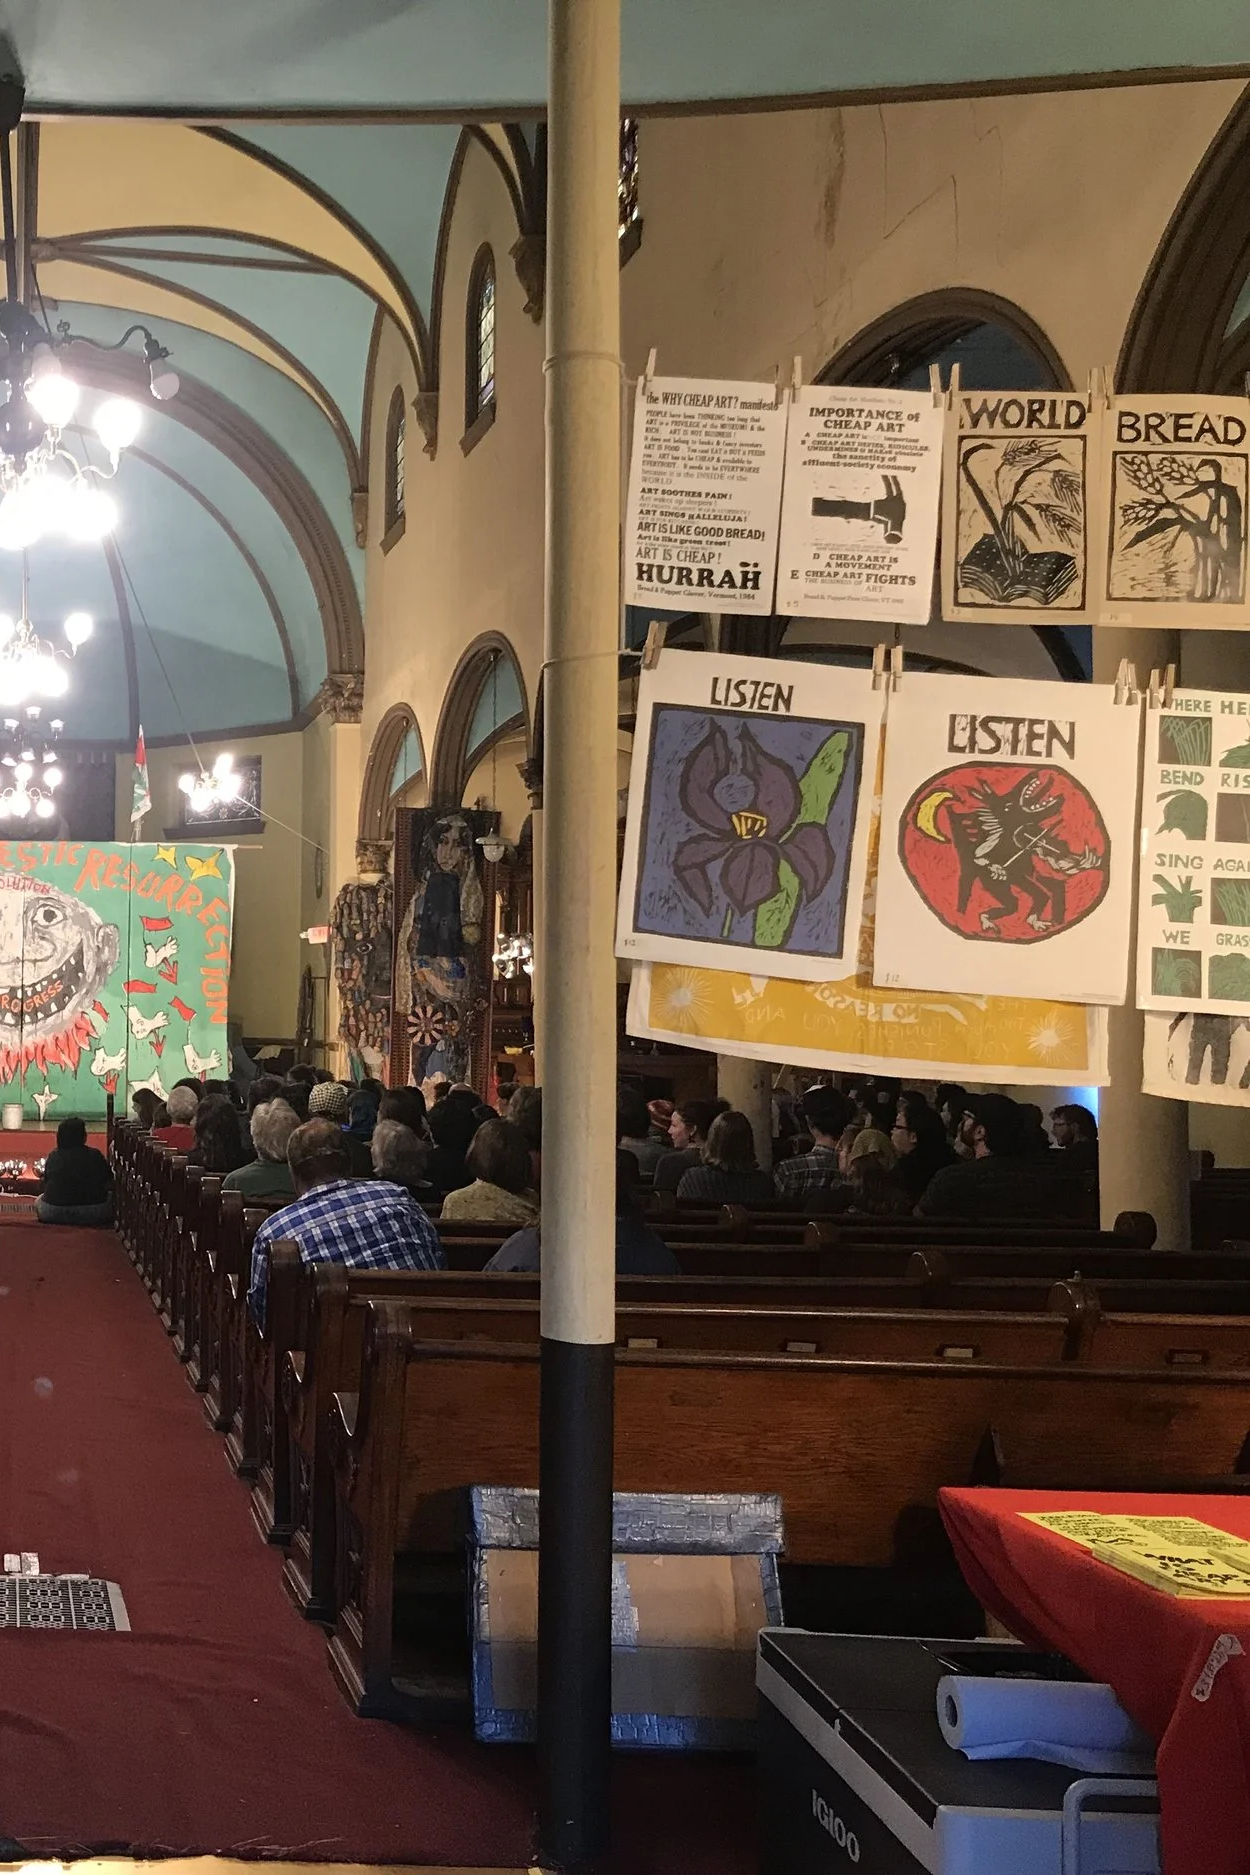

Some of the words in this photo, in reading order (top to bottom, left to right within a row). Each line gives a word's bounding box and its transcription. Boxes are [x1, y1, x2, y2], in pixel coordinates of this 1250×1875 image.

[646, 391, 660, 404] the
[662, 392, 683, 406] WHY
[683, 393, 714, 408] CHEAP
[714, 395, 739, 410] ART?
[740, 398, 779, 412] manifesto
[809, 407, 904, 421] IMPORTANCE
[906, 412, 921, 423] of
[961, 397, 1088, 430] WORLD
[823, 420, 872, 431] CHEAP
[875, 422, 906, 433] ART
[1115, 410, 1247, 447] BREAD
[640, 487, 659, 495] ART
[661, 488, 702, 498] SOOTHES
[659, 510, 686, 519] SINGS
[637, 521, 658, 533] ART
[658, 523, 668, 534] IS
[669, 524, 693, 536] LIKE
[693, 526, 724, 538] GOOD
[725, 527, 766, 542] BREAD!
[661, 535, 678, 543] like
[635, 546, 660, 560] ART
[662, 548, 673, 561] IS
[829, 553, 864, 562] CHEAP
[866, 555, 887, 564] ART
[824, 561, 832, 569] A
[835, 561, 892, 572] MOVEMENT
[790, 569, 800, 580] E
[805, 570, 840, 579] CHEAP
[842, 571, 864, 580] ART
[865, 572, 917, 587] FIGHTS
[865, 585, 885, 593] ART
[710, 676, 794, 713] LISTEN
[1220, 700, 1250, 715] HE
[947, 713, 1076, 760] LISTEN
[1160, 769, 1205, 786] BEND
[1154, 853, 1204, 870] SING
[73, 846, 232, 1024] RESURRECTION
[1162, 929, 1191, 945] WE
[1216, 933, 1250, 948] GRAS
[811, 1788, 860, 1863] IGLOO
